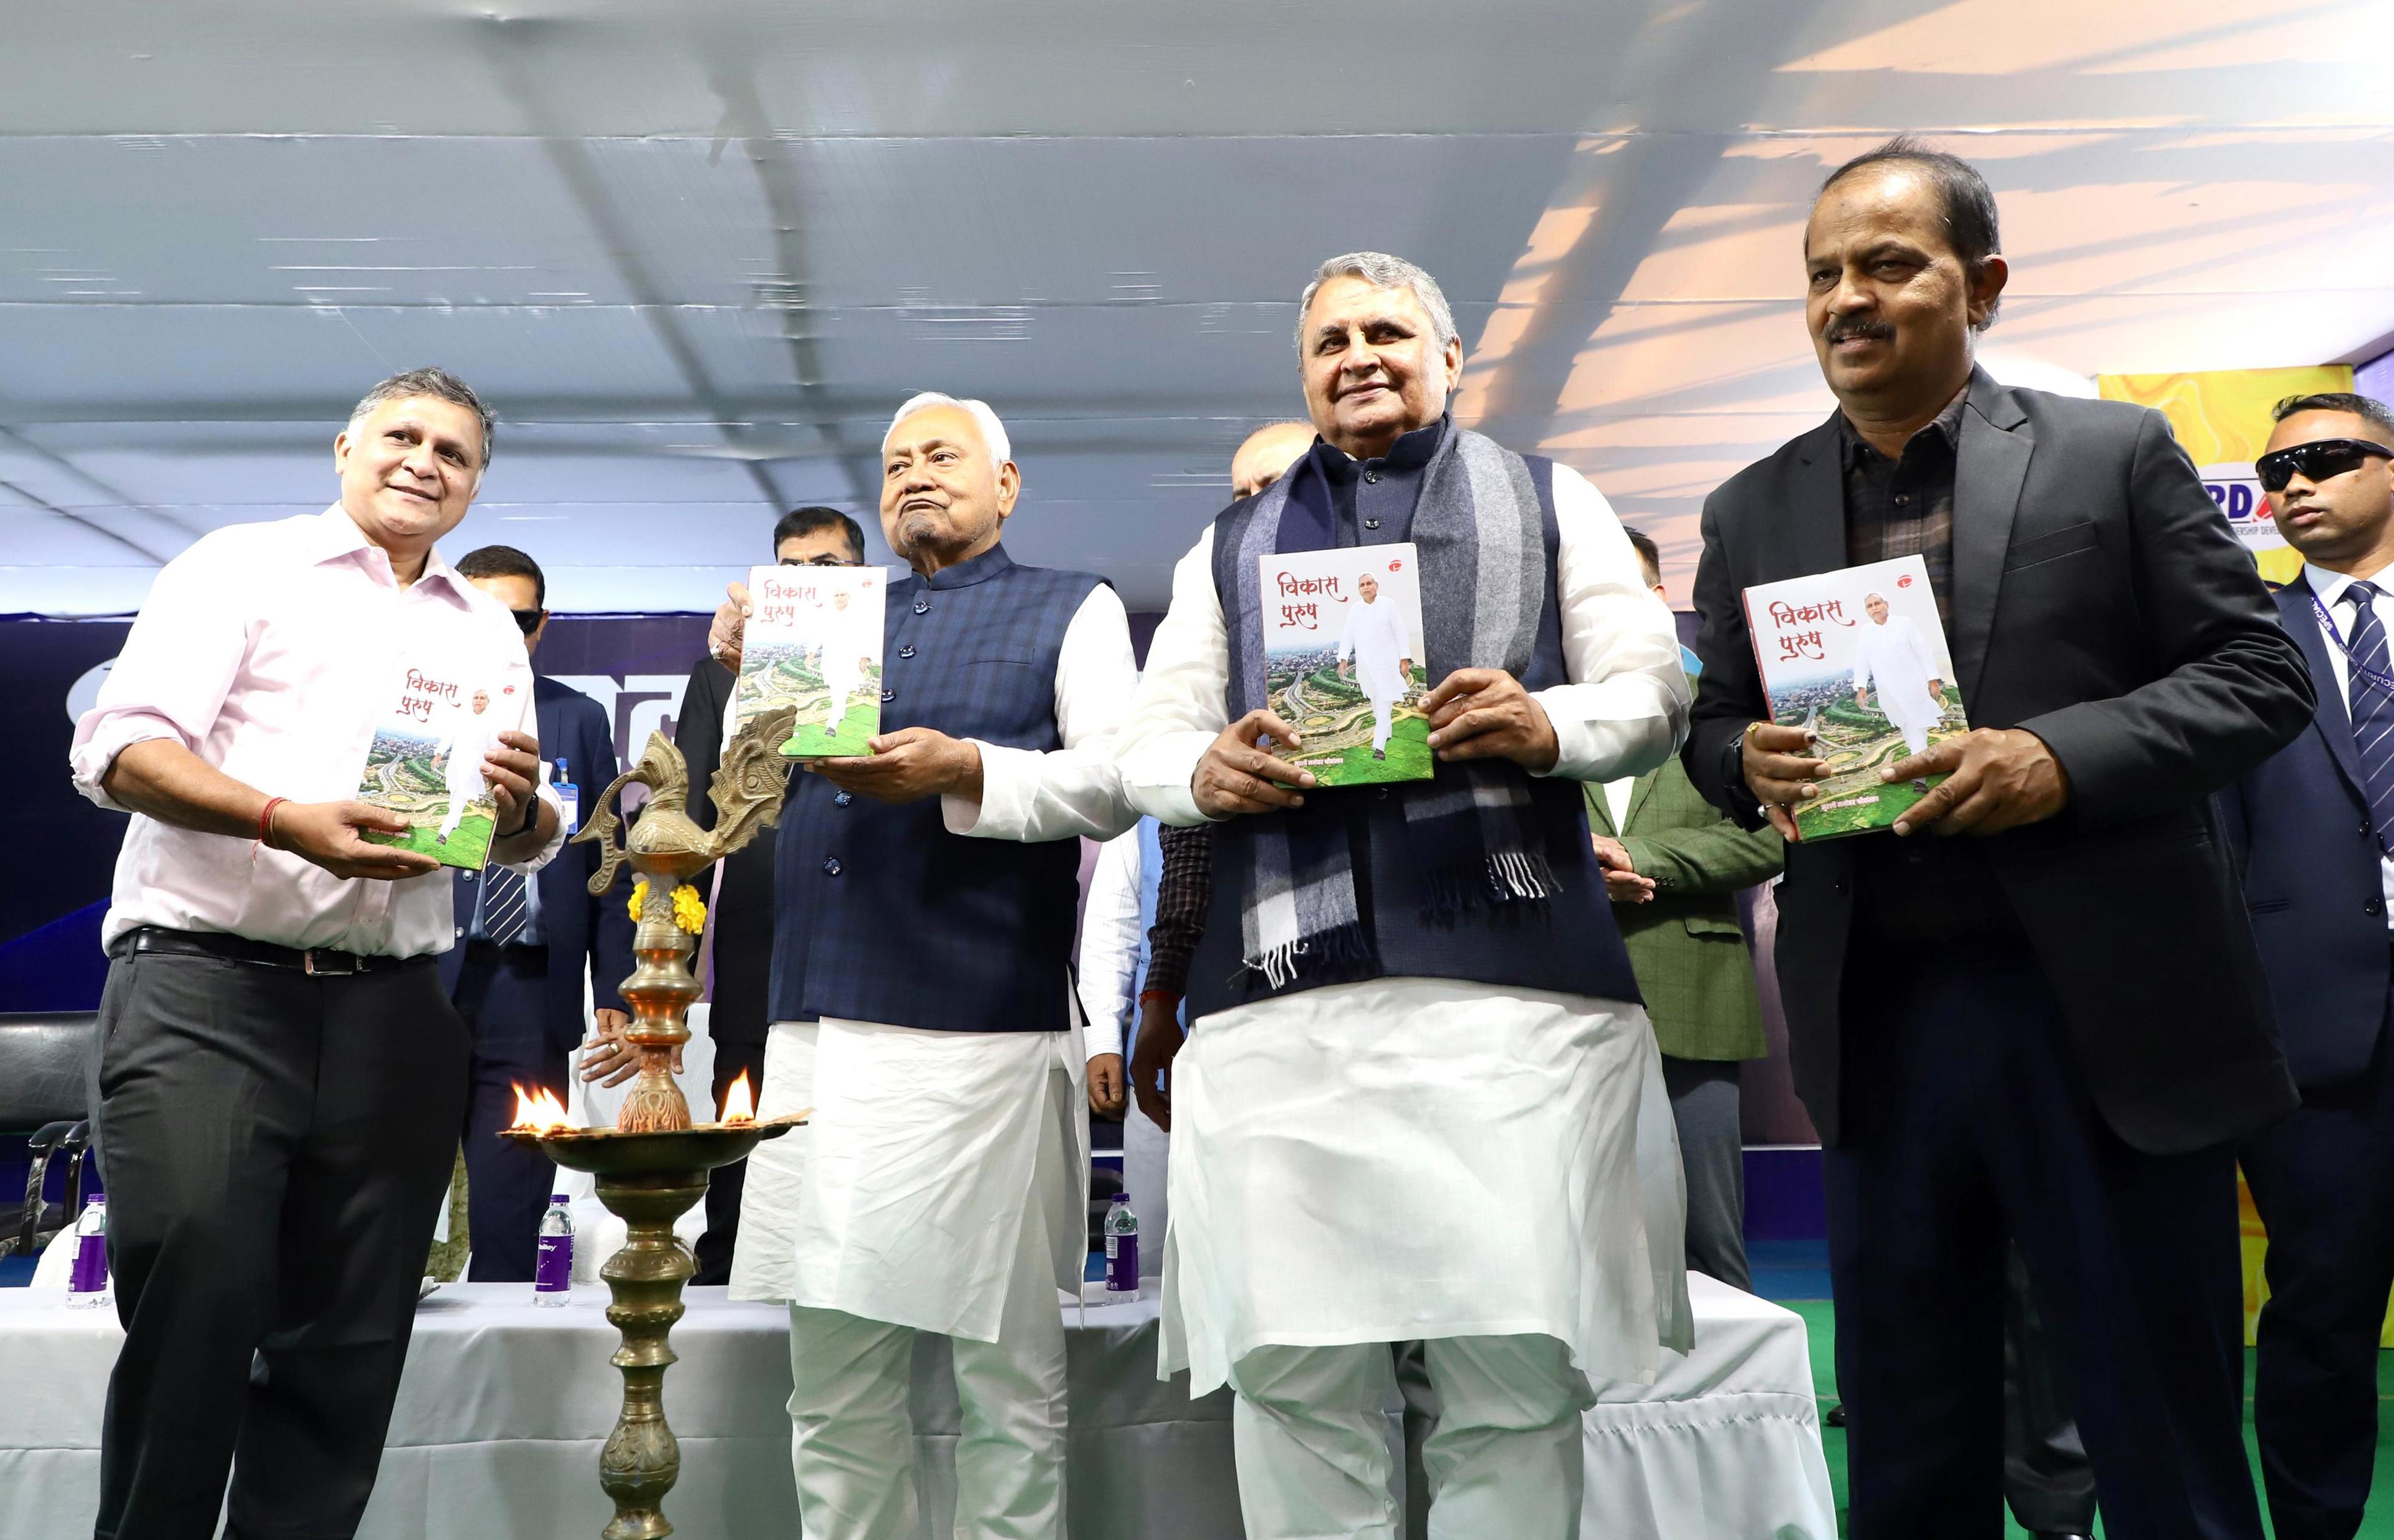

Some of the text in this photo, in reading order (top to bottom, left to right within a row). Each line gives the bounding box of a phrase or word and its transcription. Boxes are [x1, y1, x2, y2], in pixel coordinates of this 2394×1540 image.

[764, 579, 823, 607] विकास
[1277, 572, 1348, 602] विकास
[1280, 603, 1318, 630] पुरुष
[1769, 600, 1855, 628] विकास
[1779, 631, 1825, 661] पुरुष
[407, 668, 461, 708] विकास
[396, 695, 434, 723] पुरुष
